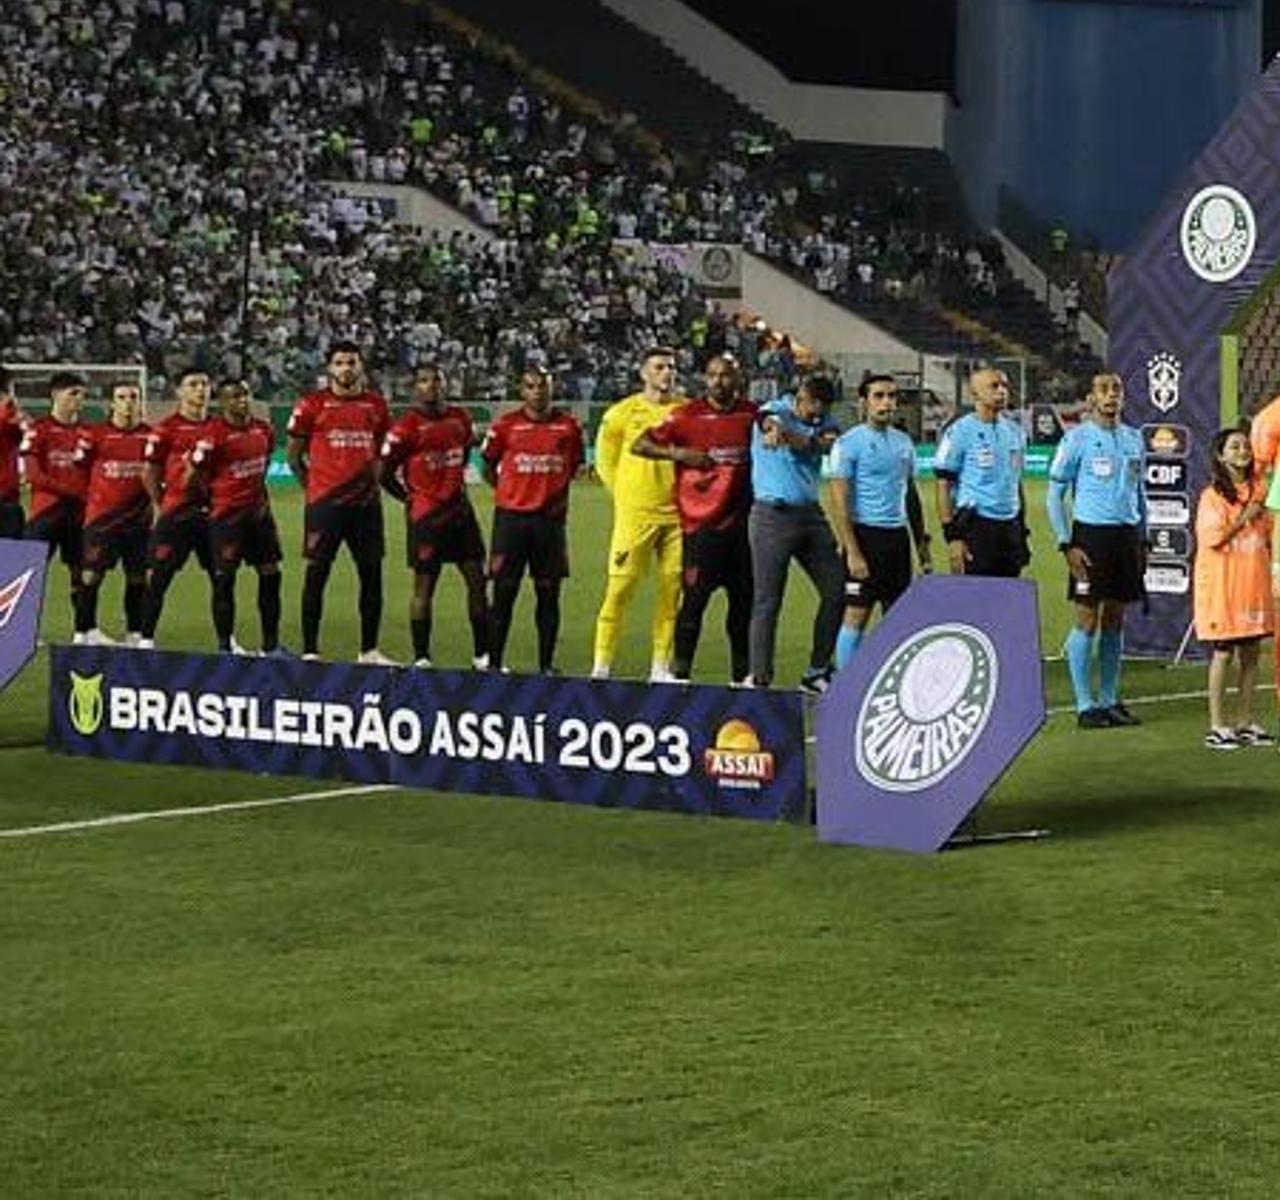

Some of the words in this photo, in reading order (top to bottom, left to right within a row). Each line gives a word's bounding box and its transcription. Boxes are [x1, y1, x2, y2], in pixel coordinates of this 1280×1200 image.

[1147, 465, 1182, 485] CBF
[110, 687, 421, 754] BRASILEIRÃO
[429, 710, 547, 764] ASSAÍ
[559, 718, 692, 776] 2023
[863, 693, 982, 780] PALMEIRAS
